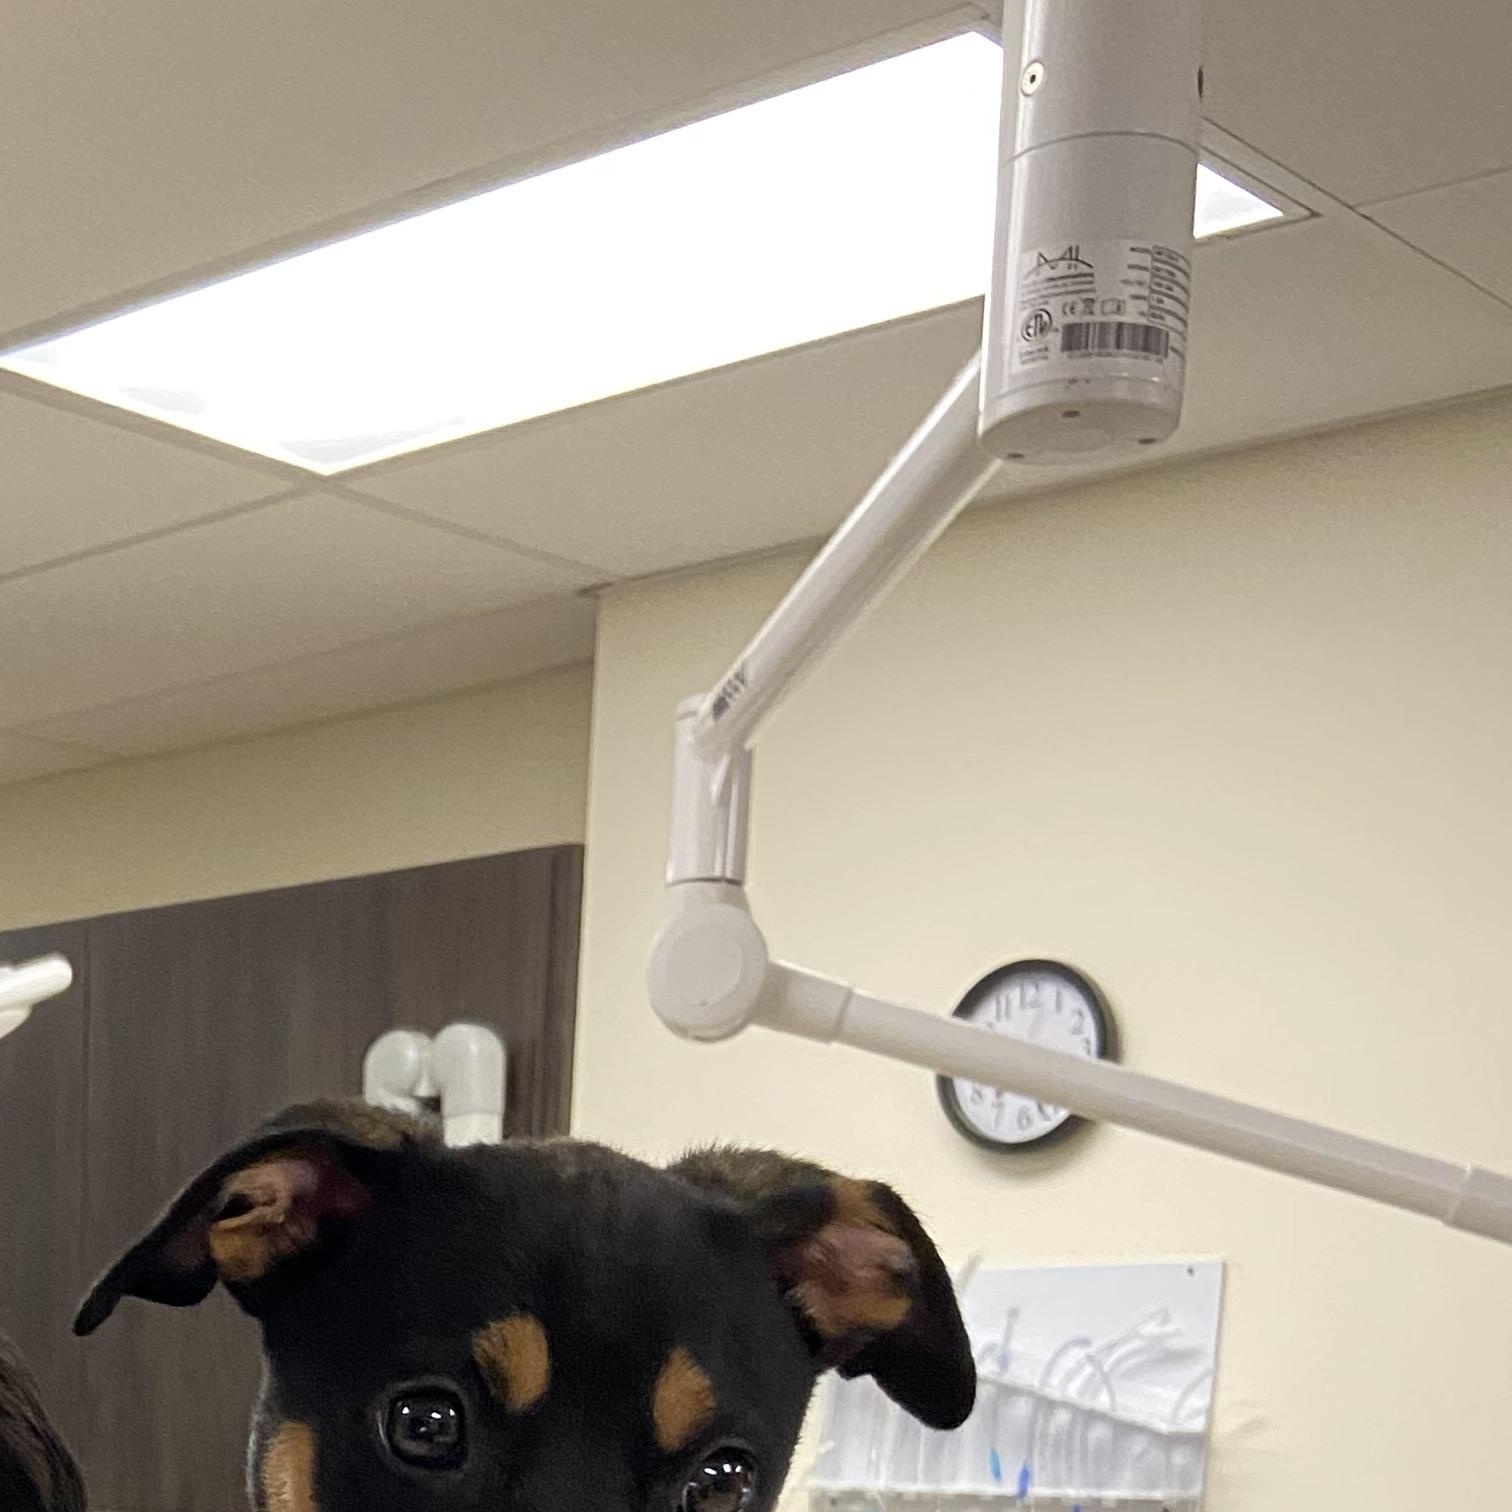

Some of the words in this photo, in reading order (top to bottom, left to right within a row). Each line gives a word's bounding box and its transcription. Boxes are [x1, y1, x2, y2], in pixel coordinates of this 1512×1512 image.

[995, 993, 1012, 1022] 11
[1020, 980, 1043, 1010] 12
[1070, 1007, 1085, 1035] 2
[1016, 1104, 1032, 1131] 6
